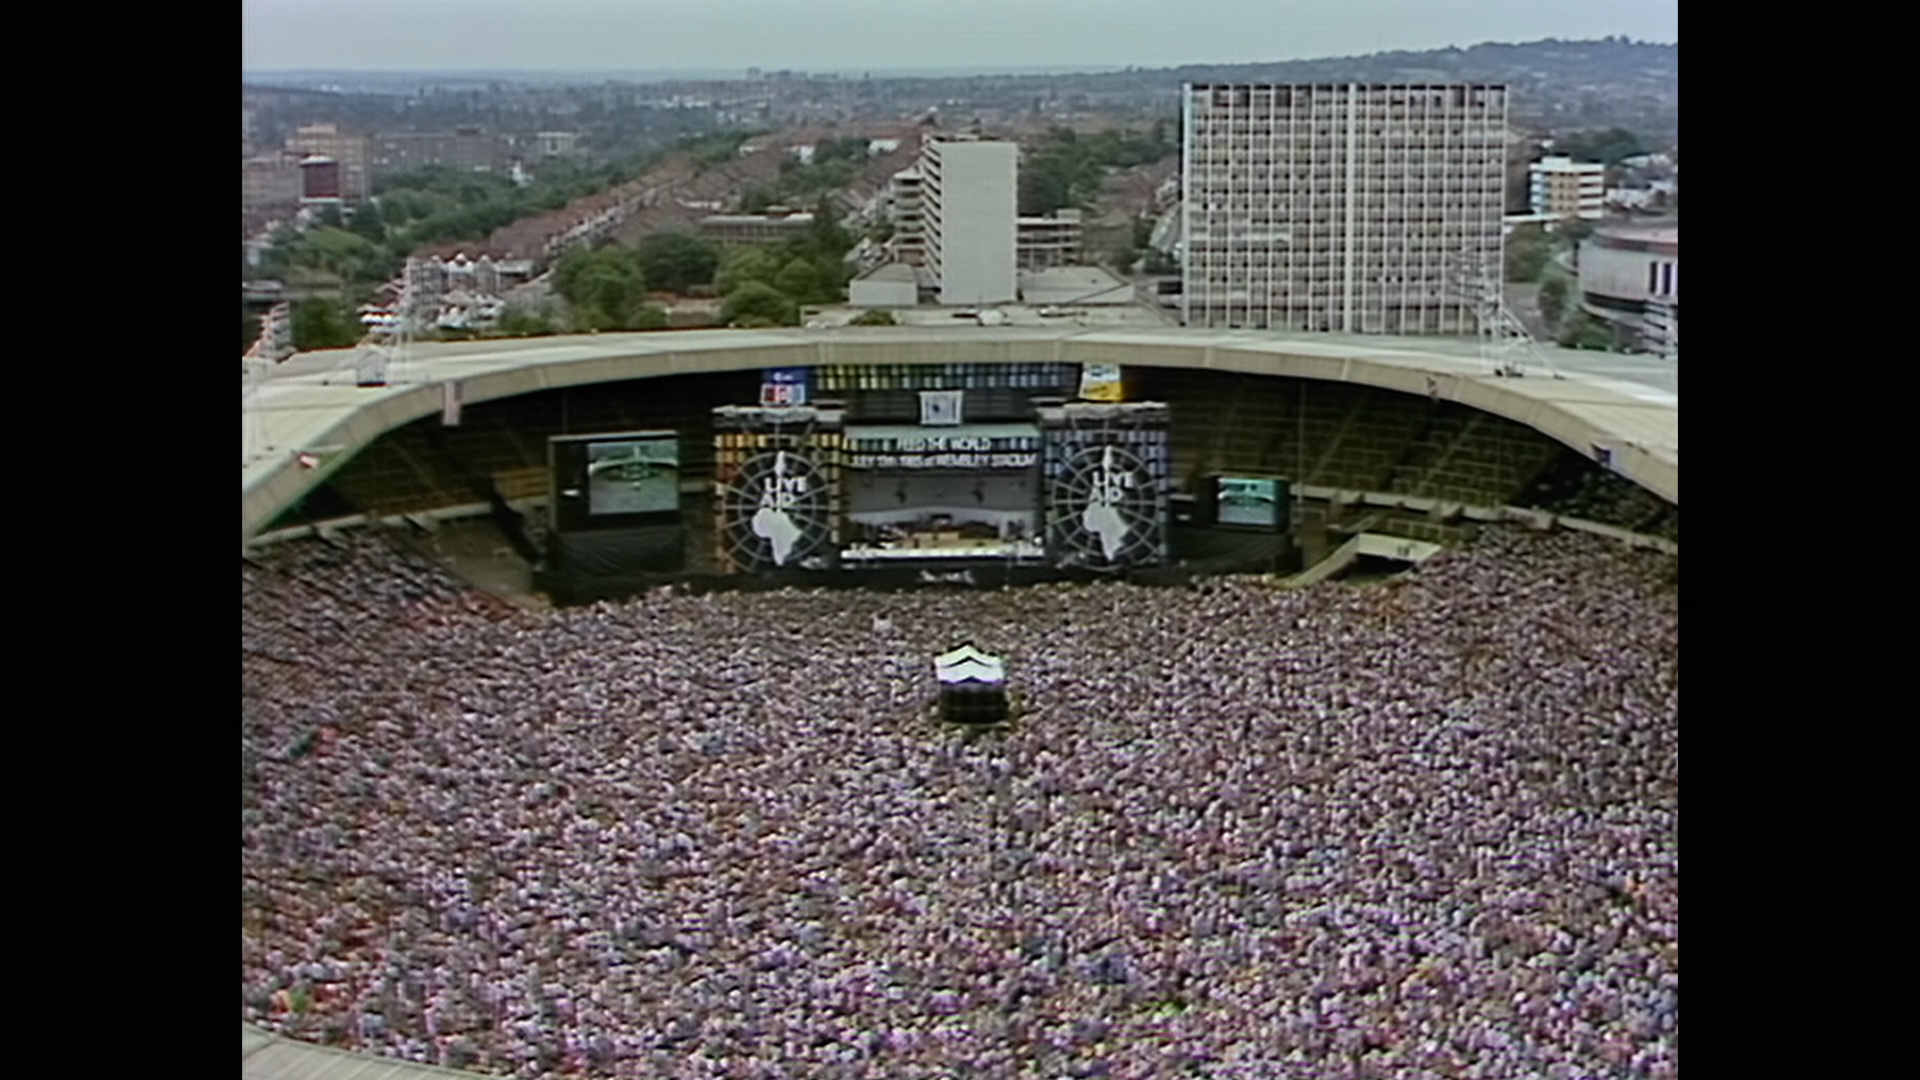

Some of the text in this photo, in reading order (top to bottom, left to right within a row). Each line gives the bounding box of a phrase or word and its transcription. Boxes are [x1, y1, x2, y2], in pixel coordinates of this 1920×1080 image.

[927, 436, 949, 450] THE
[951, 435, 991, 450] WORLD
[764, 477, 806, 492] LIVE
[1092, 471, 1133, 488] LIVE
[760, 493, 795, 508] AID
[1088, 487, 1123, 504] AID
